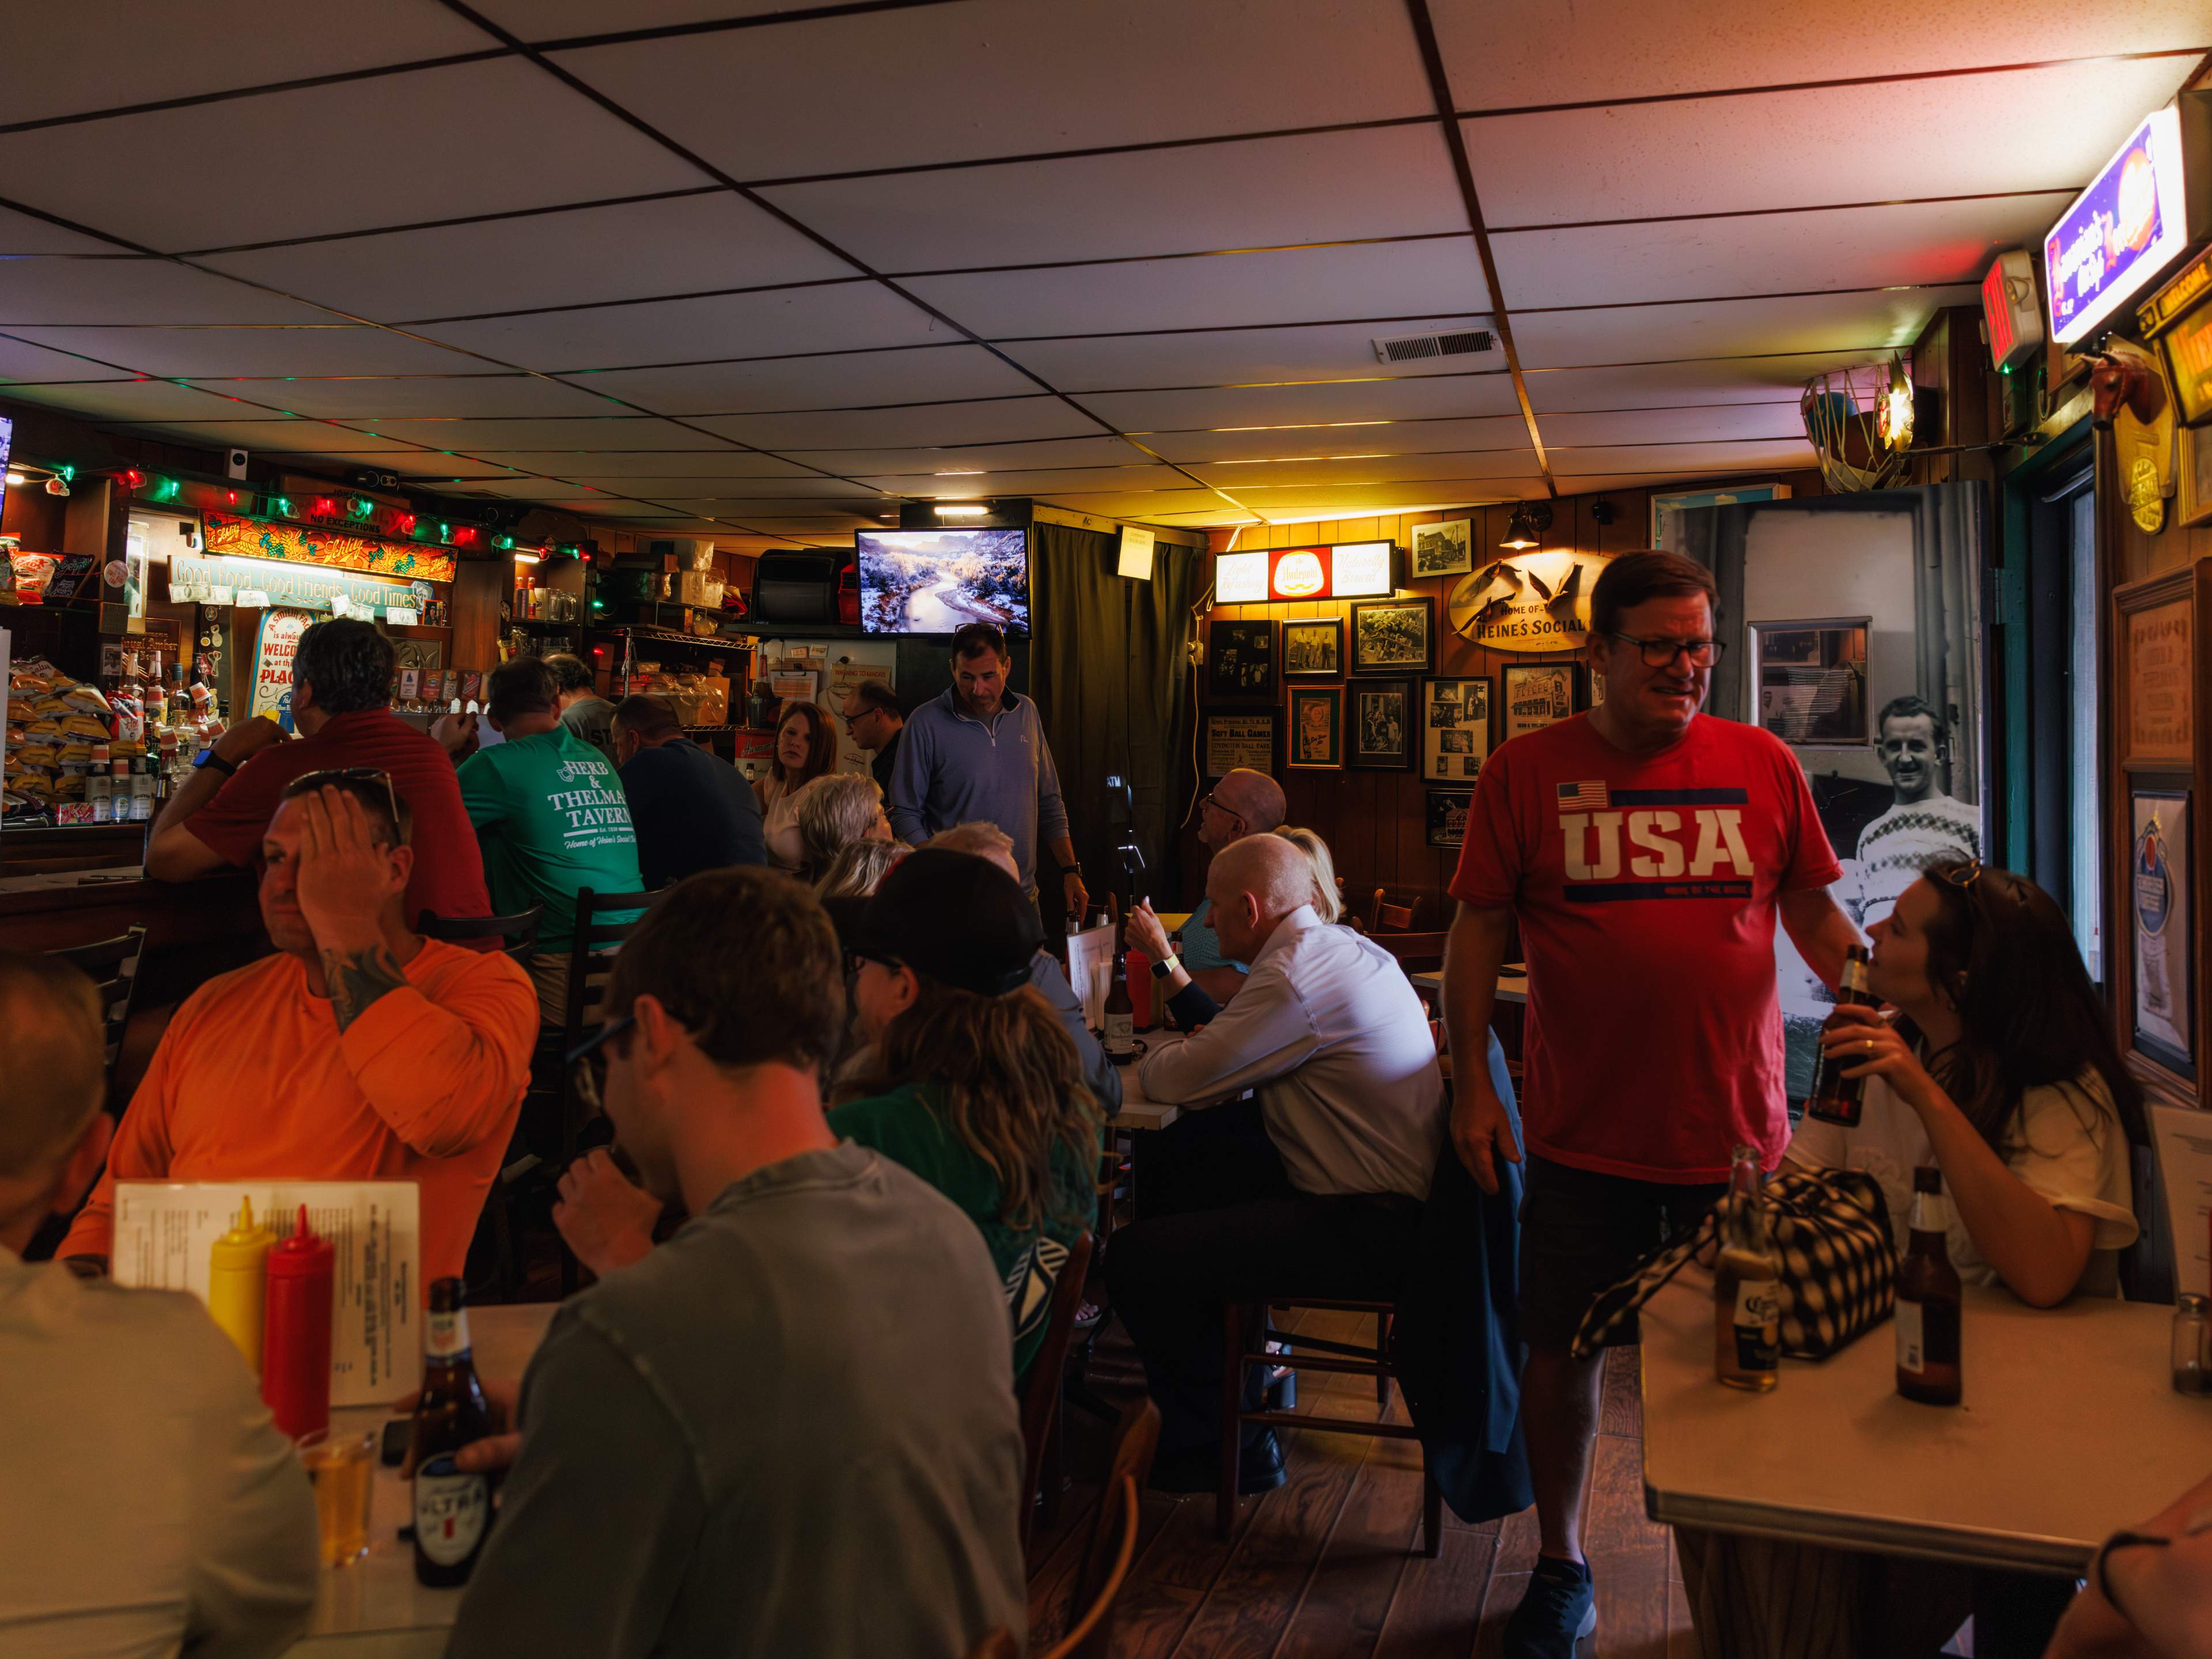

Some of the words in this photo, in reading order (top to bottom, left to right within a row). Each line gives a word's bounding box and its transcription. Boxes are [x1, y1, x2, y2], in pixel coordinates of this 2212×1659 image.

[310, 514, 324, 524] NO
[327, 516, 381, 534] EXCEPTIONS
[217, 524, 240, 543] Schlitz
[323, 537, 363, 564] Schlitz
[1282, 566, 1319, 582] Hudepohl
[1341, 570, 1378, 584] Brewed
[176, 559, 213, 585] Good
[262, 571, 295, 594] Good
[351, 581, 380, 605] Good
[382, 586, 415, 608] Times
[1500, 604, 1526, 616] HOME
[268, 624, 275, 632] A
[298, 614, 312, 630] FAC
[1476, 619, 1528, 639] HEINE'S
[1531, 619, 1586, 635] SOCIAL
[264, 643, 297, 657] WELCO
[260, 669, 294, 684] PLAC
[1212, 729, 1227, 737] SOFT
[1230, 729, 1245, 737] BALL
[1247, 729, 1271, 737] GAMES
[563, 760, 609, 775] HERB
[589, 775, 601, 789] &
[1107, 775, 1121, 787] ATM
[547, 789, 627, 811] THELMA
[565, 840, 588, 850] Home
[589, 837, 596, 848] of
[1559, 808, 1755, 881] USA
